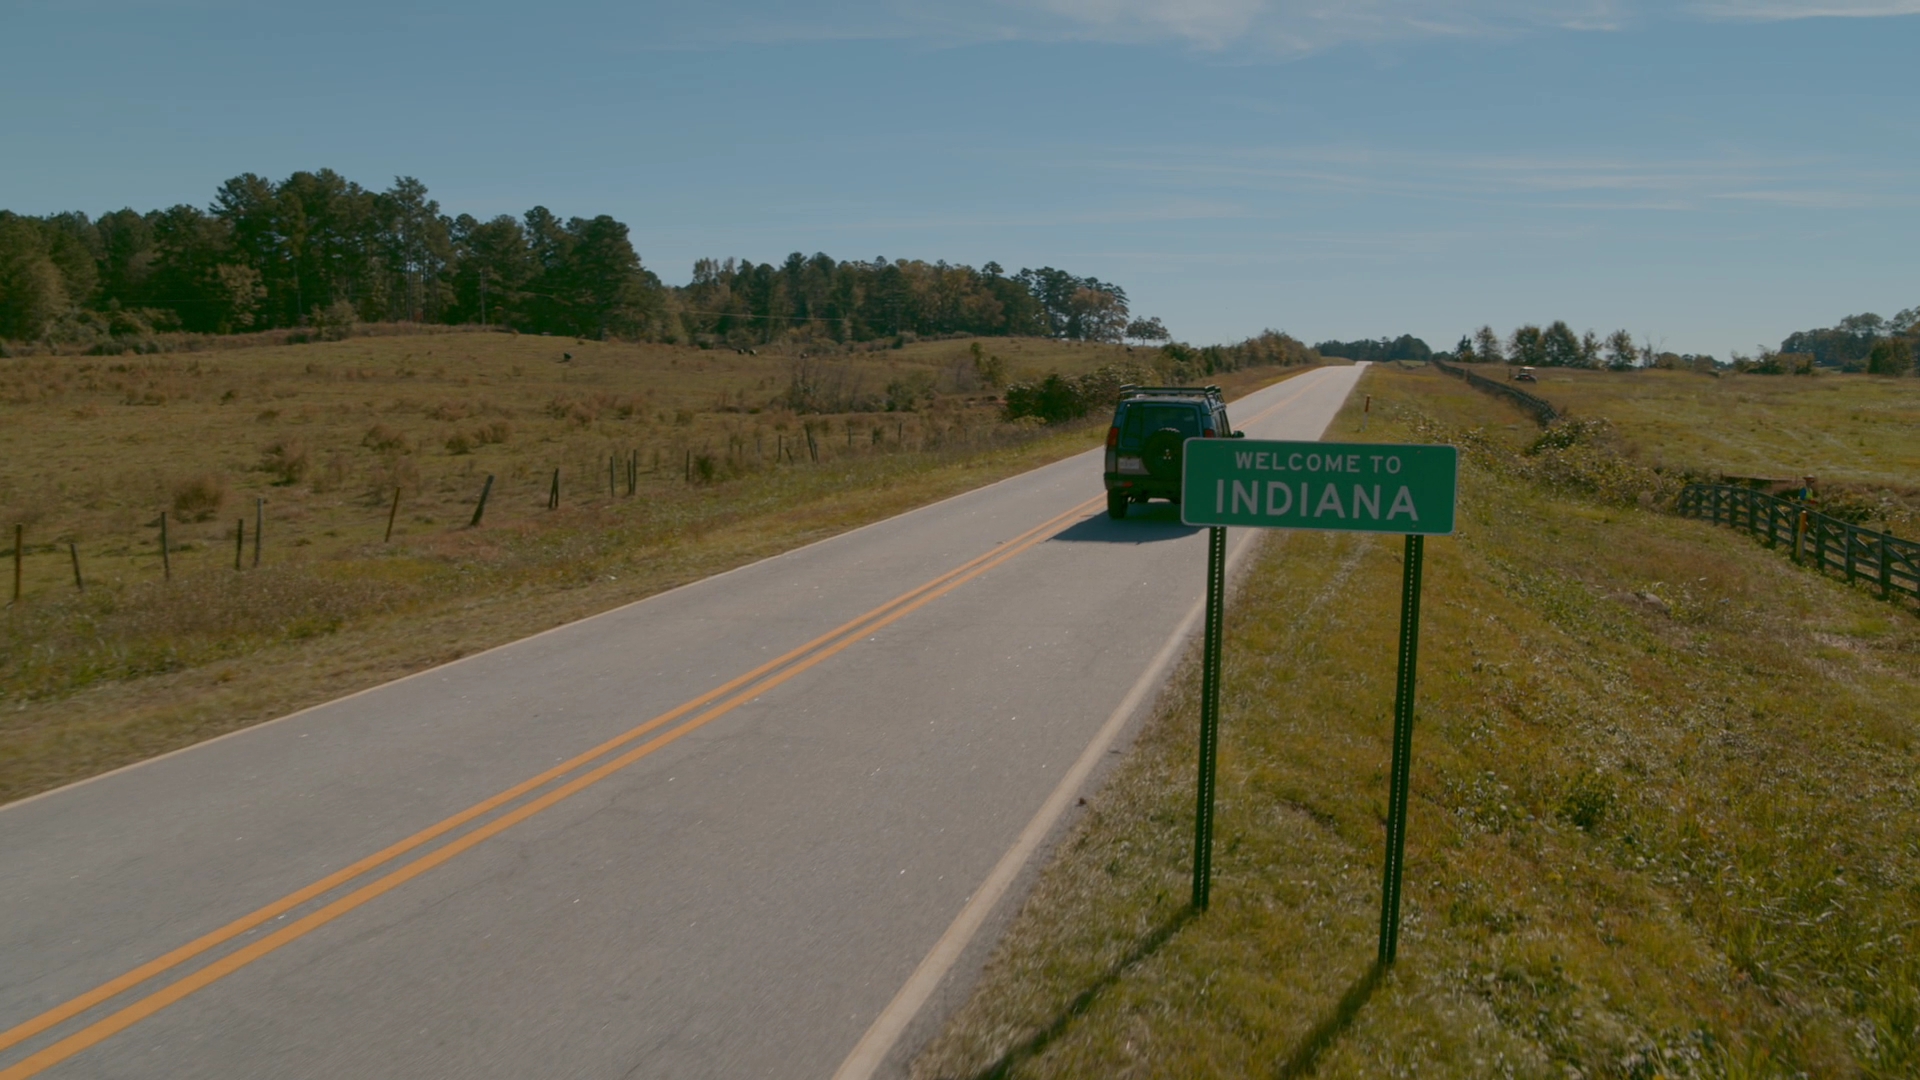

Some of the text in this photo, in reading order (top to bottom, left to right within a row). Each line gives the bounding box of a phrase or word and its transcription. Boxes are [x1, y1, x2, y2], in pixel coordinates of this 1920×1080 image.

[1235, 451, 1401, 474] WELCOME TO
[1216, 479, 1419, 521] INDIANA
